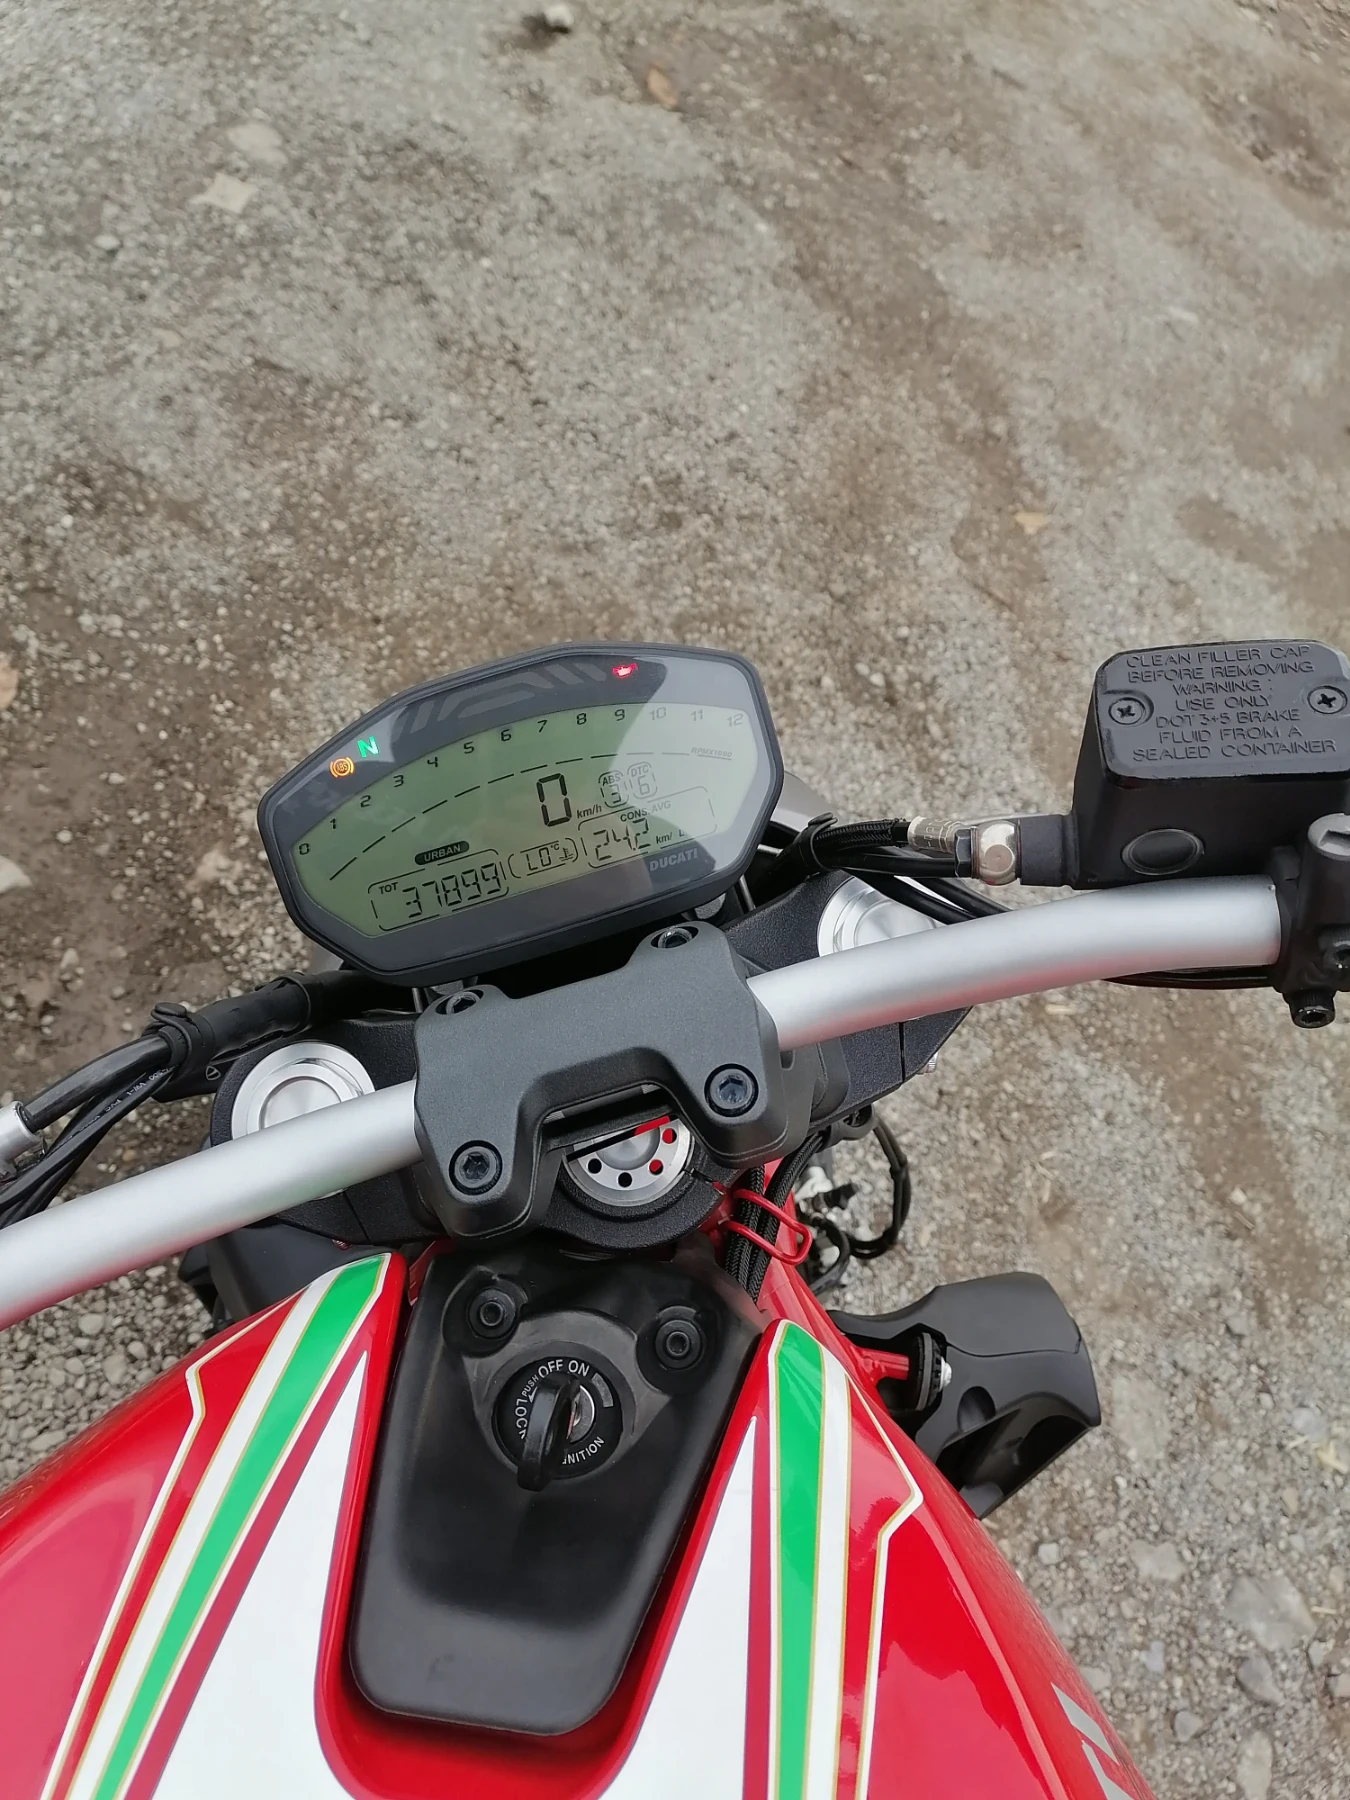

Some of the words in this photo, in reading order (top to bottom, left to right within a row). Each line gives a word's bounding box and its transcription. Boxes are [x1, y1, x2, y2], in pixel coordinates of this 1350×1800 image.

[1126, 653, 1191, 668] CLEAN
[1198, 648, 1262, 663] FILLER
[1270, 645, 1310, 659] CAP
[1128, 667, 1206, 683] BEFORE
[1211, 661, 1315, 679] REMOVING
[1175, 698, 1215, 711] USE
[1224, 694, 1270, 709] ONLY
[576, 712, 587, 726] 8
[614, 708, 626, 722] 9
[649, 706, 668, 721] 10
[691, 709, 705, 722] 11
[727, 713, 744, 727] 12
[1156, 714, 1194, 728] DOT
[1237, 708, 1300, 724] BRAKE
[537, 719, 548, 733] 7
[500, 728, 512, 742] 6
[1159, 729, 1211, 744] FLUID
[1220, 727, 1280, 741] FROM
[1288, 725, 1303, 738] A
[357, 736, 379, 758] N
[463, 741, 475, 754] 5
[1133, 745, 1211, 761] SEALED
[1221, 740, 1336, 757] CONTAINER
[427, 756, 438, 768] 4
[630, 764, 649, 778] DTC
[393, 775, 404, 788] 3
[602, 773, 621, 787] ABS
[360, 795, 371, 808] 2
[536, 773, 572, 827] 0
[576, 803, 602, 819] km/h
[651, 800, 672, 815] AVG
[329, 818, 337, 830] 1
[298, 842, 310, 855] 0
[424, 843, 462, 862] URBAN
[650, 847, 698, 872] DUCATI
[378, 882, 398, 895] TOT
[402, 862, 501, 918] 37899
[538, 1359, 564, 1379] OFF
[568, 1360, 590, 1377] ON
[521, 1374, 540, 1397] PUSH
[562, 1436, 605, 1465] NITION
